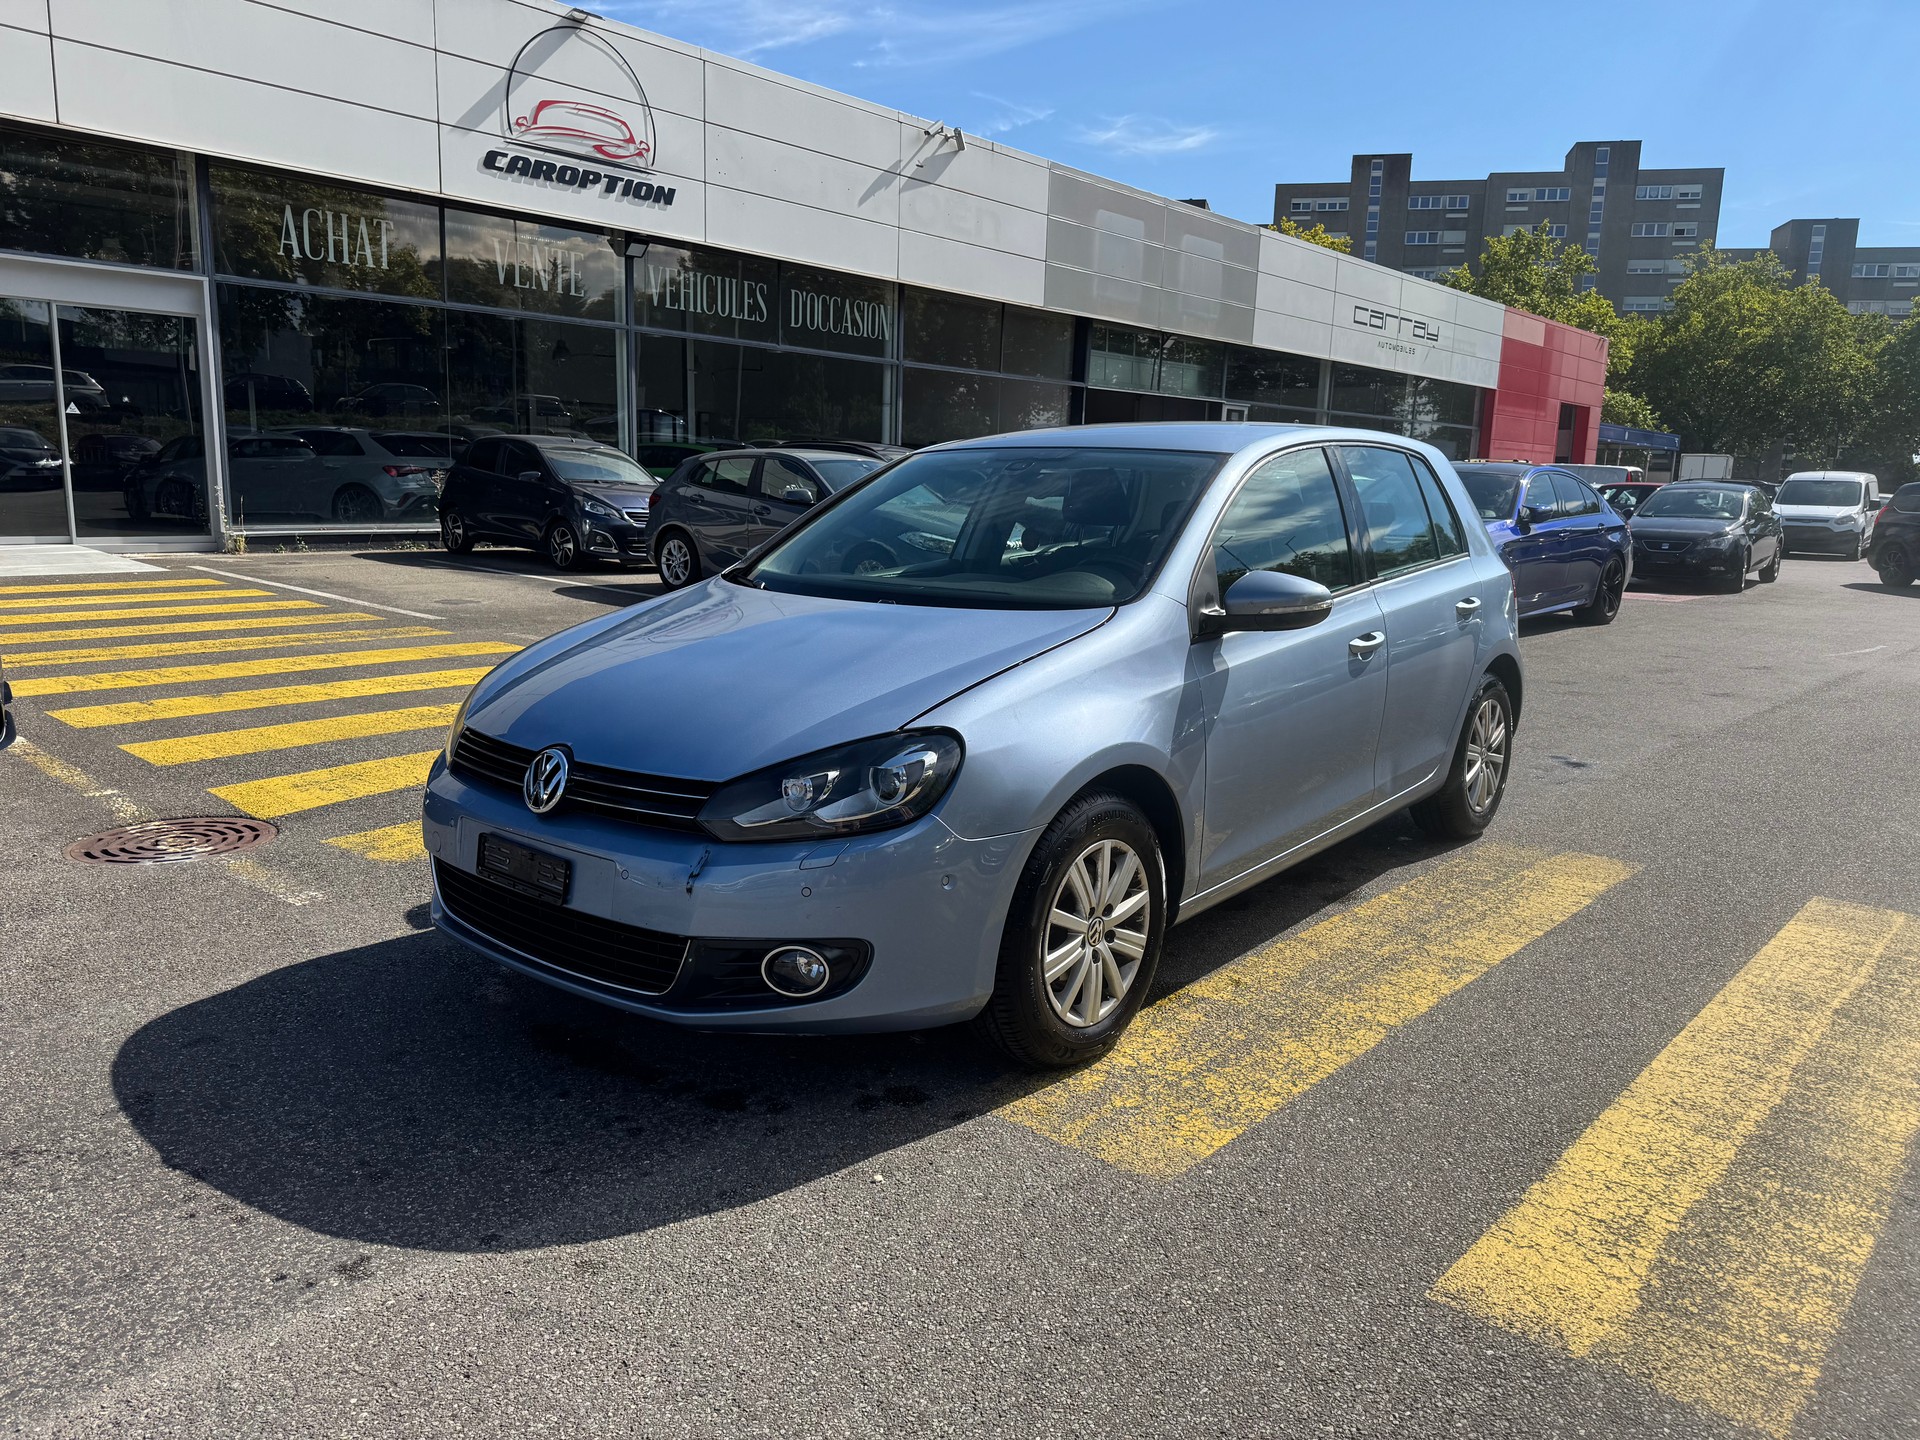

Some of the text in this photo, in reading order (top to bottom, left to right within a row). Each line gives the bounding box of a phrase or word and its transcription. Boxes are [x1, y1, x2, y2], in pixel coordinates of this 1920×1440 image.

[483, 150, 677, 206] CAROPTION
[277, 204, 892, 341] ACHAT VENTE VEHICULES D'OCCASION
[1353, 305, 1440, 342] carray
[1377, 341, 1416, 355] AUTOMOBILES
